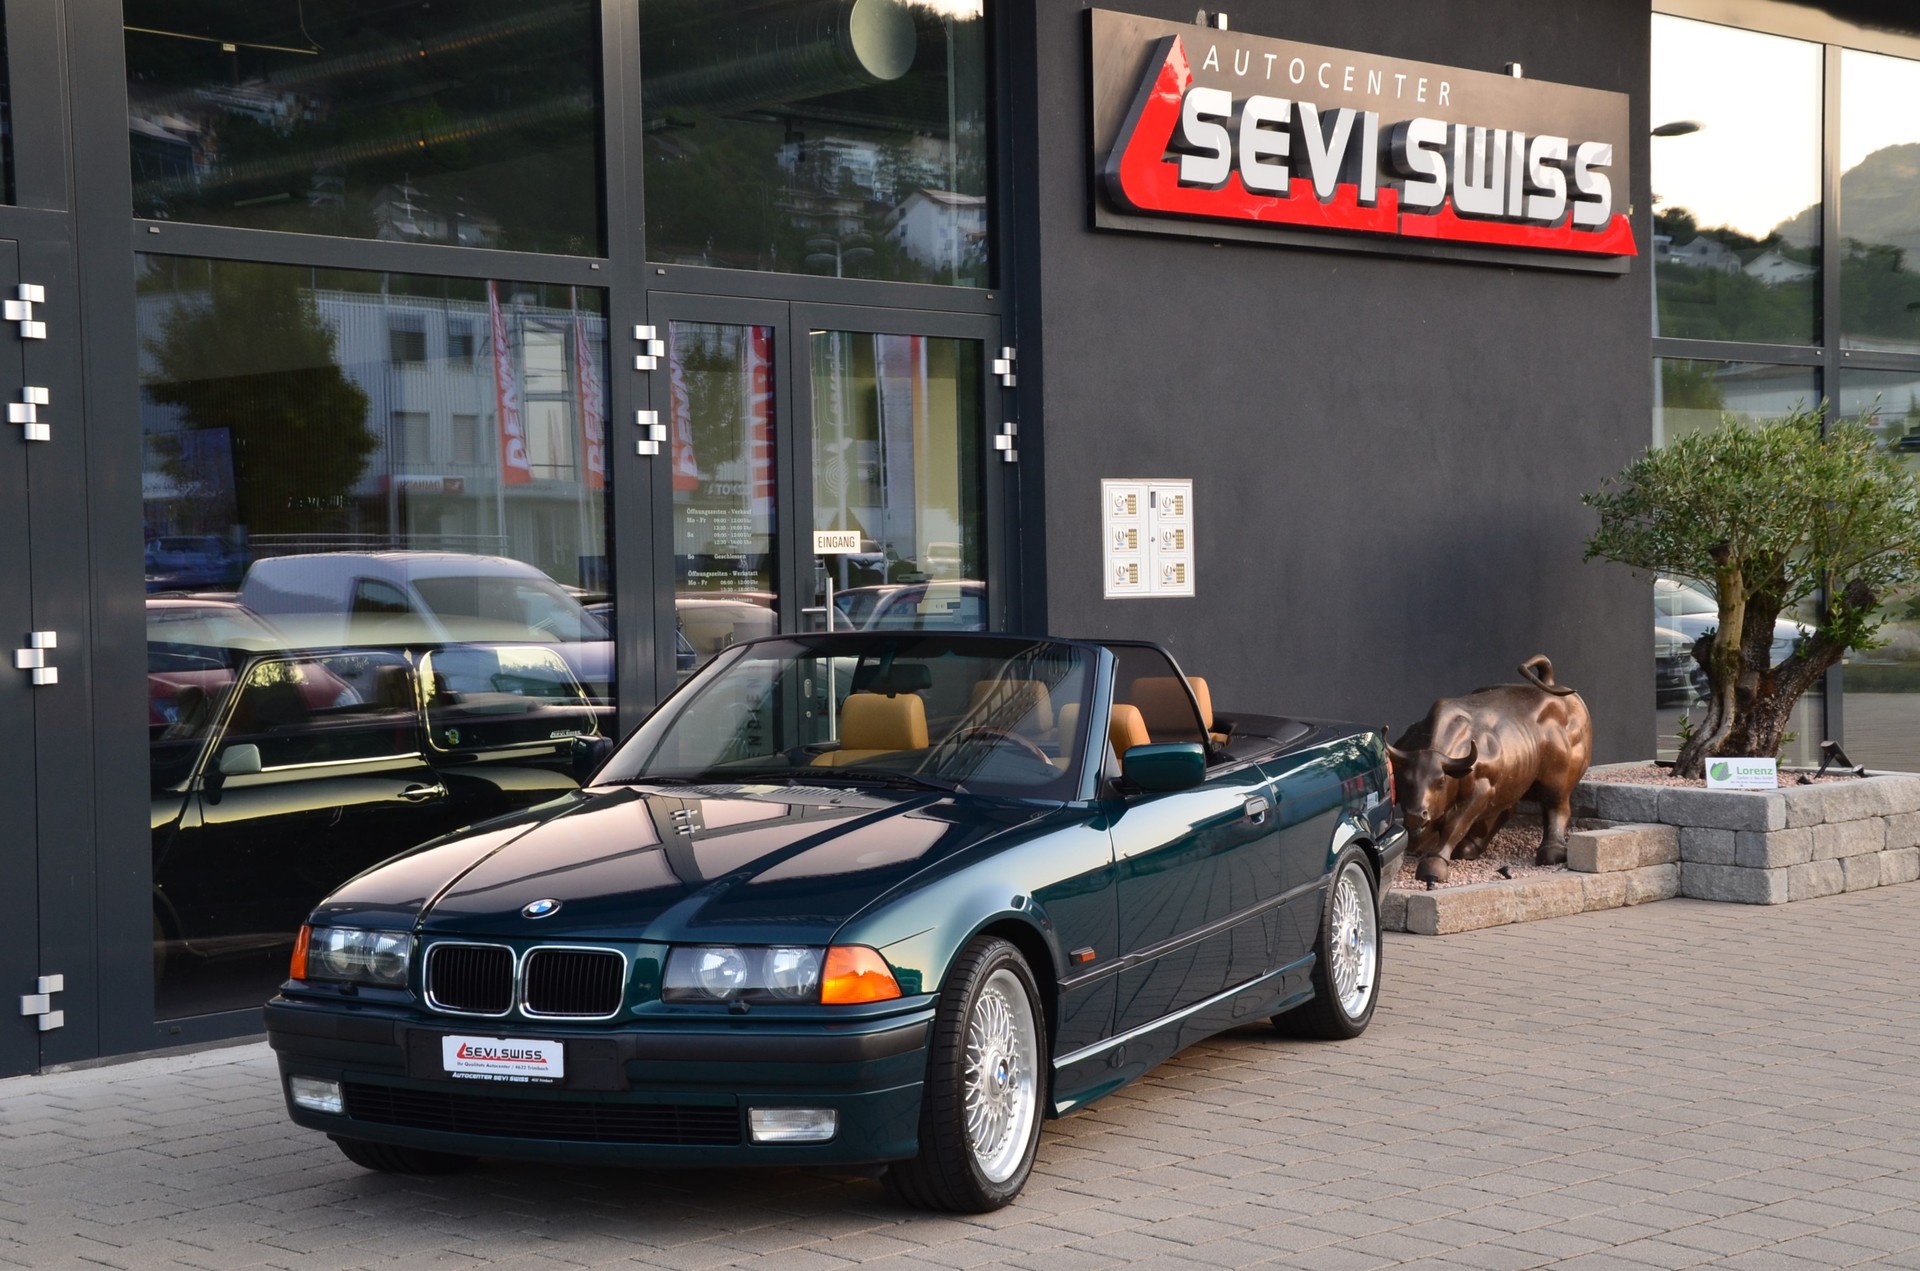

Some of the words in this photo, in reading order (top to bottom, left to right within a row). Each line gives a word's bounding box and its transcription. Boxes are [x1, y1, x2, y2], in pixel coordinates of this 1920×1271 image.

[1203, 44, 1451, 107] AUTOCENTER
[1179, 86, 1379, 204] SEVI
[1404, 117, 1612, 227] SWISS
[817, 536, 856, 549] EINGANG
[1736, 766, 1773, 775] Lorenz
[465, 1046, 497, 1057] SEVI
[501, 1048, 542, 1060] SWISS
[494, 1074, 509, 1082] SEVI
[510, 1075, 529, 1083] SWISS
